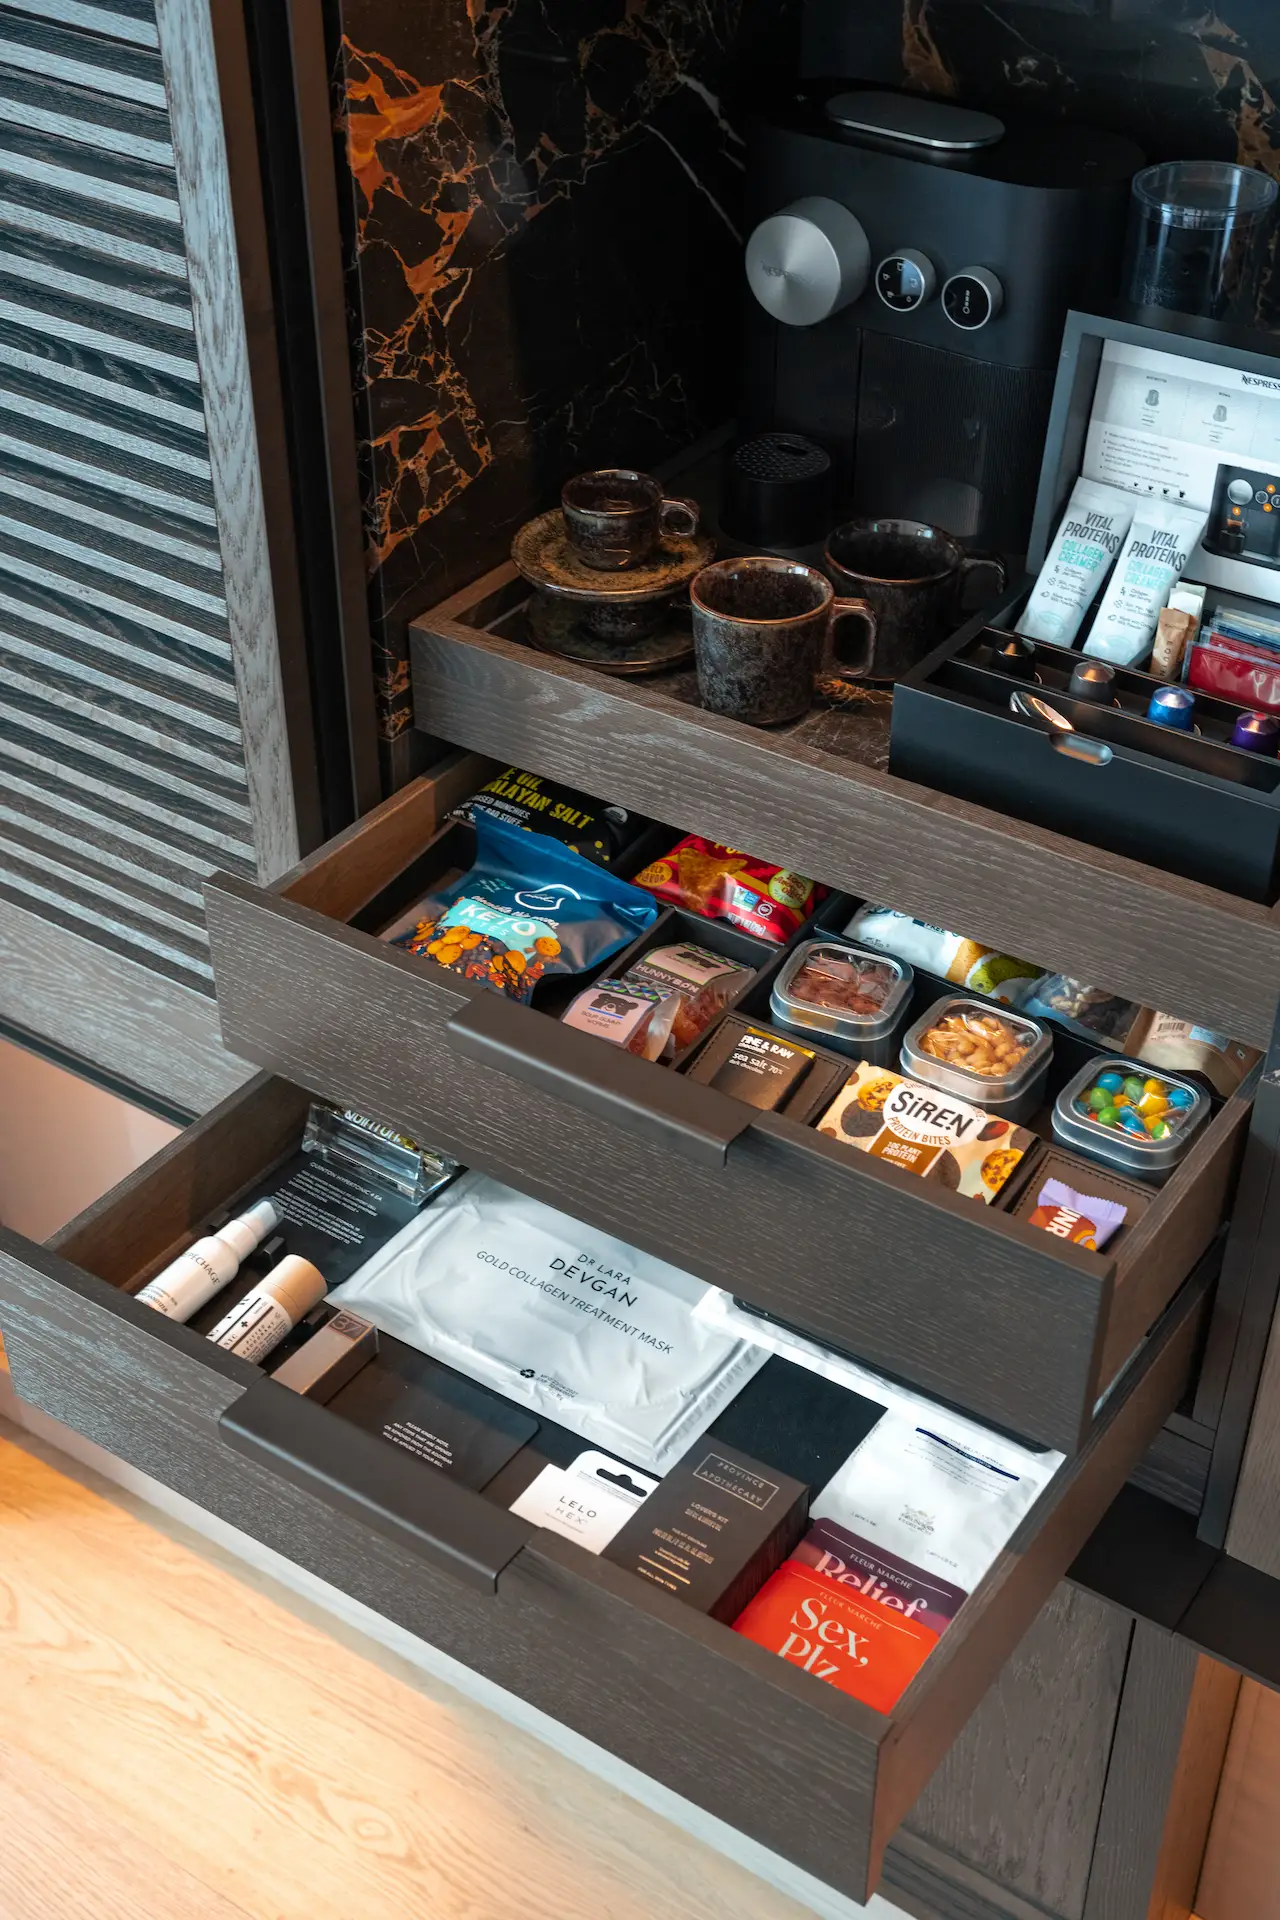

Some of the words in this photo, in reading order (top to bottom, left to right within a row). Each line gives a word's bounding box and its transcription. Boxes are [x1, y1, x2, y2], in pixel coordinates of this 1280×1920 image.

[1085, 512, 1113, 531] VITAL
[1061, 540, 1104, 562] COLLAGEN
[1062, 521, 1120, 554] PROTEINS
[1150, 530, 1179, 549] VITAL
[1127, 540, 1186, 572] PROTEINS
[516, 773, 542, 790] OIL
[549, 803, 595, 829] SALT
[458, 904, 537, 936] KETO
[462, 918, 509, 937] BITES
[740, 1035, 763, 1048] FINE
[761, 1041, 771, 1051] &
[770, 1044, 795, 1059] RAW
[732, 1052, 749, 1062] sea
[749, 1057, 768, 1070] salt
[769, 1064, 783, 1075] 70%
[889, 1116, 919, 1141] PROTEIN
[921, 1133, 951, 1146] BITES
[881, 1147, 921, 1163] PROTEIN
[900, 1145, 923, 1157] PLANT
[309, 1162, 336, 1177] QUINTON
[336, 1175, 371, 1194] HYPERTONIC
[549, 1257, 638, 1307] DEVGAN
[577, 1253, 595, 1266] DR
[596, 1264, 631, 1285] LARA
[476, 1250, 509, 1270] GOLD
[508, 1266, 570, 1301] COLLAGEN
[569, 1296, 640, 1336] TREATMENT
[638, 1332, 674, 1354] MASK
[411, 1439, 423, 1447] FROM
[415, 1434, 425, 1442] THAT
[422, 1453, 434, 1461] YOUR
[701, 1470, 763, 1504] APOTHECARY
[716, 1461, 765, 1489] PROVINCE
[560, 1496, 597, 1518] LELO
[718, 1515, 729, 1523] KIT
[814, 1549, 928, 1617] Relief
[849, 1553, 875, 1571] FLEUR
[877, 1567, 913, 1590] MARCHÉ
[819, 1591, 844, 1608] FLEUR
[847, 1606, 883, 1630] MARCHÉ
[790, 1598, 870, 1668] Sex,
[778, 1631, 841, 1678] Plz
